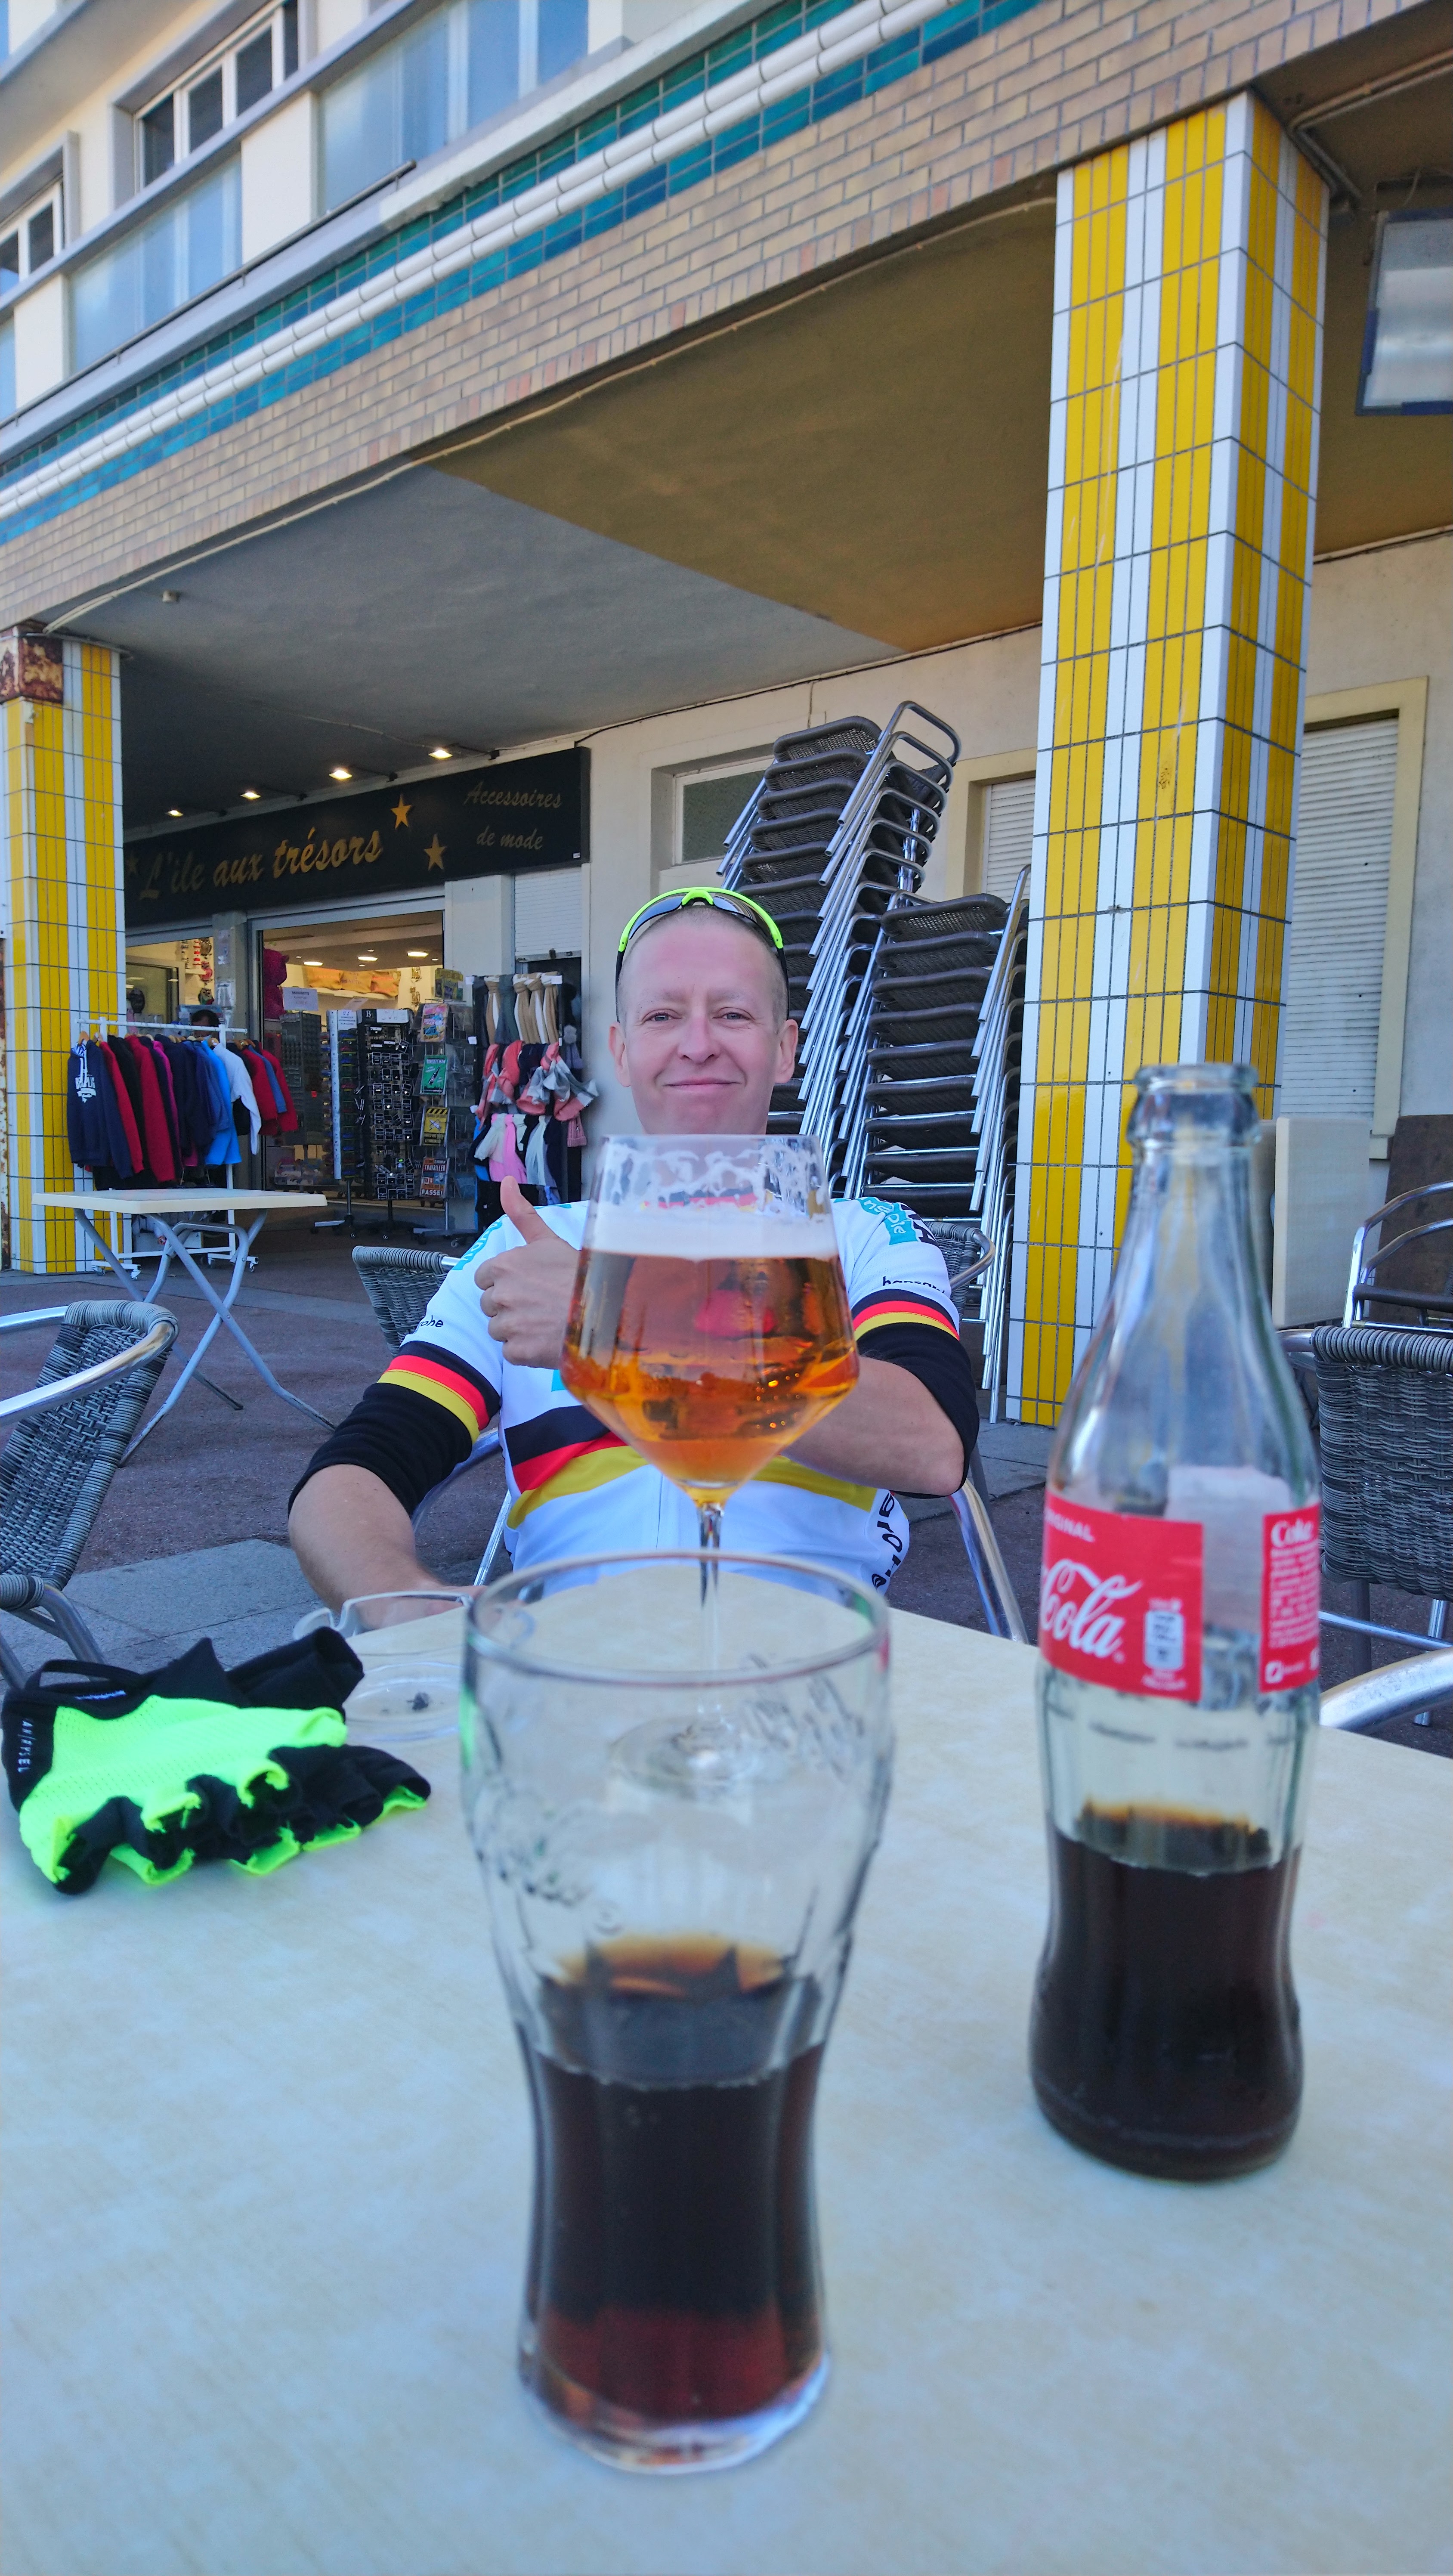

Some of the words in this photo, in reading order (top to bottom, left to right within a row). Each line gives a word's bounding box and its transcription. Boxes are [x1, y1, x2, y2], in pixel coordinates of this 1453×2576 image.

[463, 781, 562, 808] Accessoires
[476, 825, 495, 846] de
[500, 827, 544, 850] mode
[213, 853, 264, 888] aux
[273, 826, 383, 879] trésors
